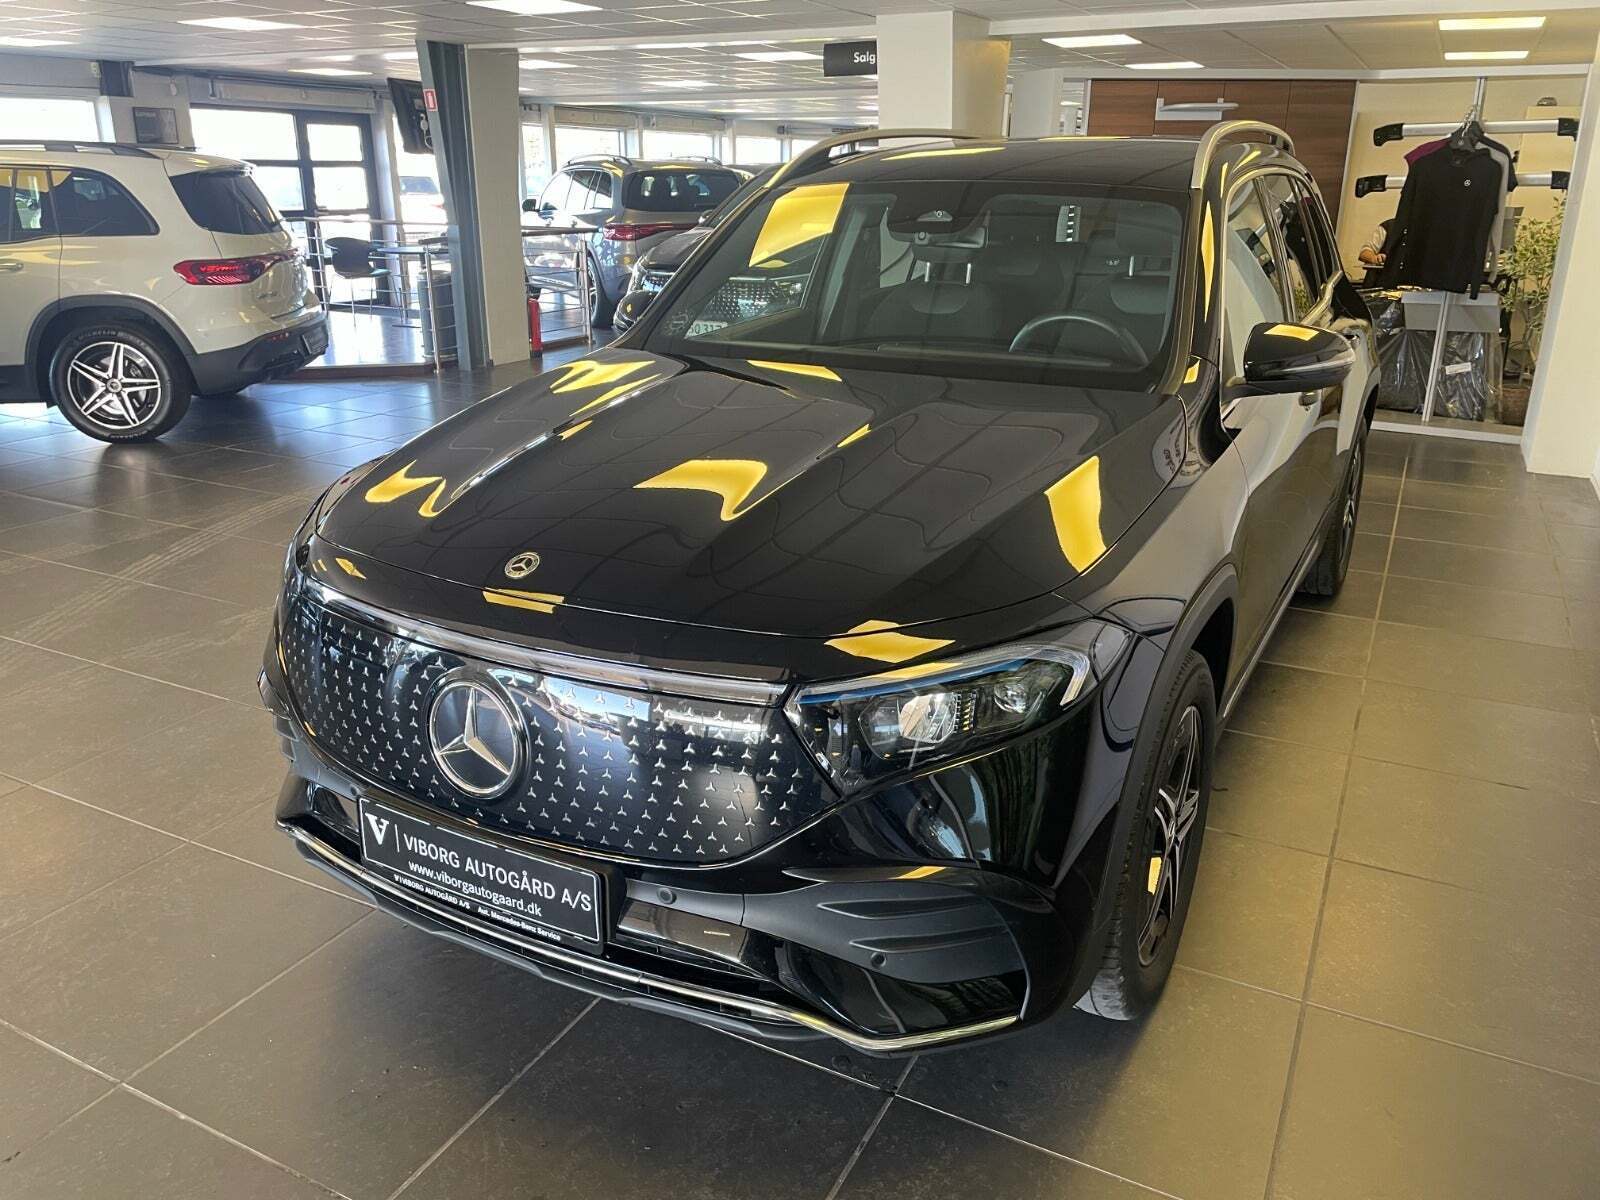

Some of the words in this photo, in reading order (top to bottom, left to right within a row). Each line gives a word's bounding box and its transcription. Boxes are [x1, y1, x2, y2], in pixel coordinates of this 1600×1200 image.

[853, 50, 876, 65] Salg
[403, 833, 460, 868] VIBORG
[465, 856, 556, 900] AUTOGÅRD
[561, 888, 592, 911] A/S
[408, 860, 542, 917] www.viborgautogaard.dk
[402, 877, 424, 892] VIBORG
[537, 927, 561, 941] Service
